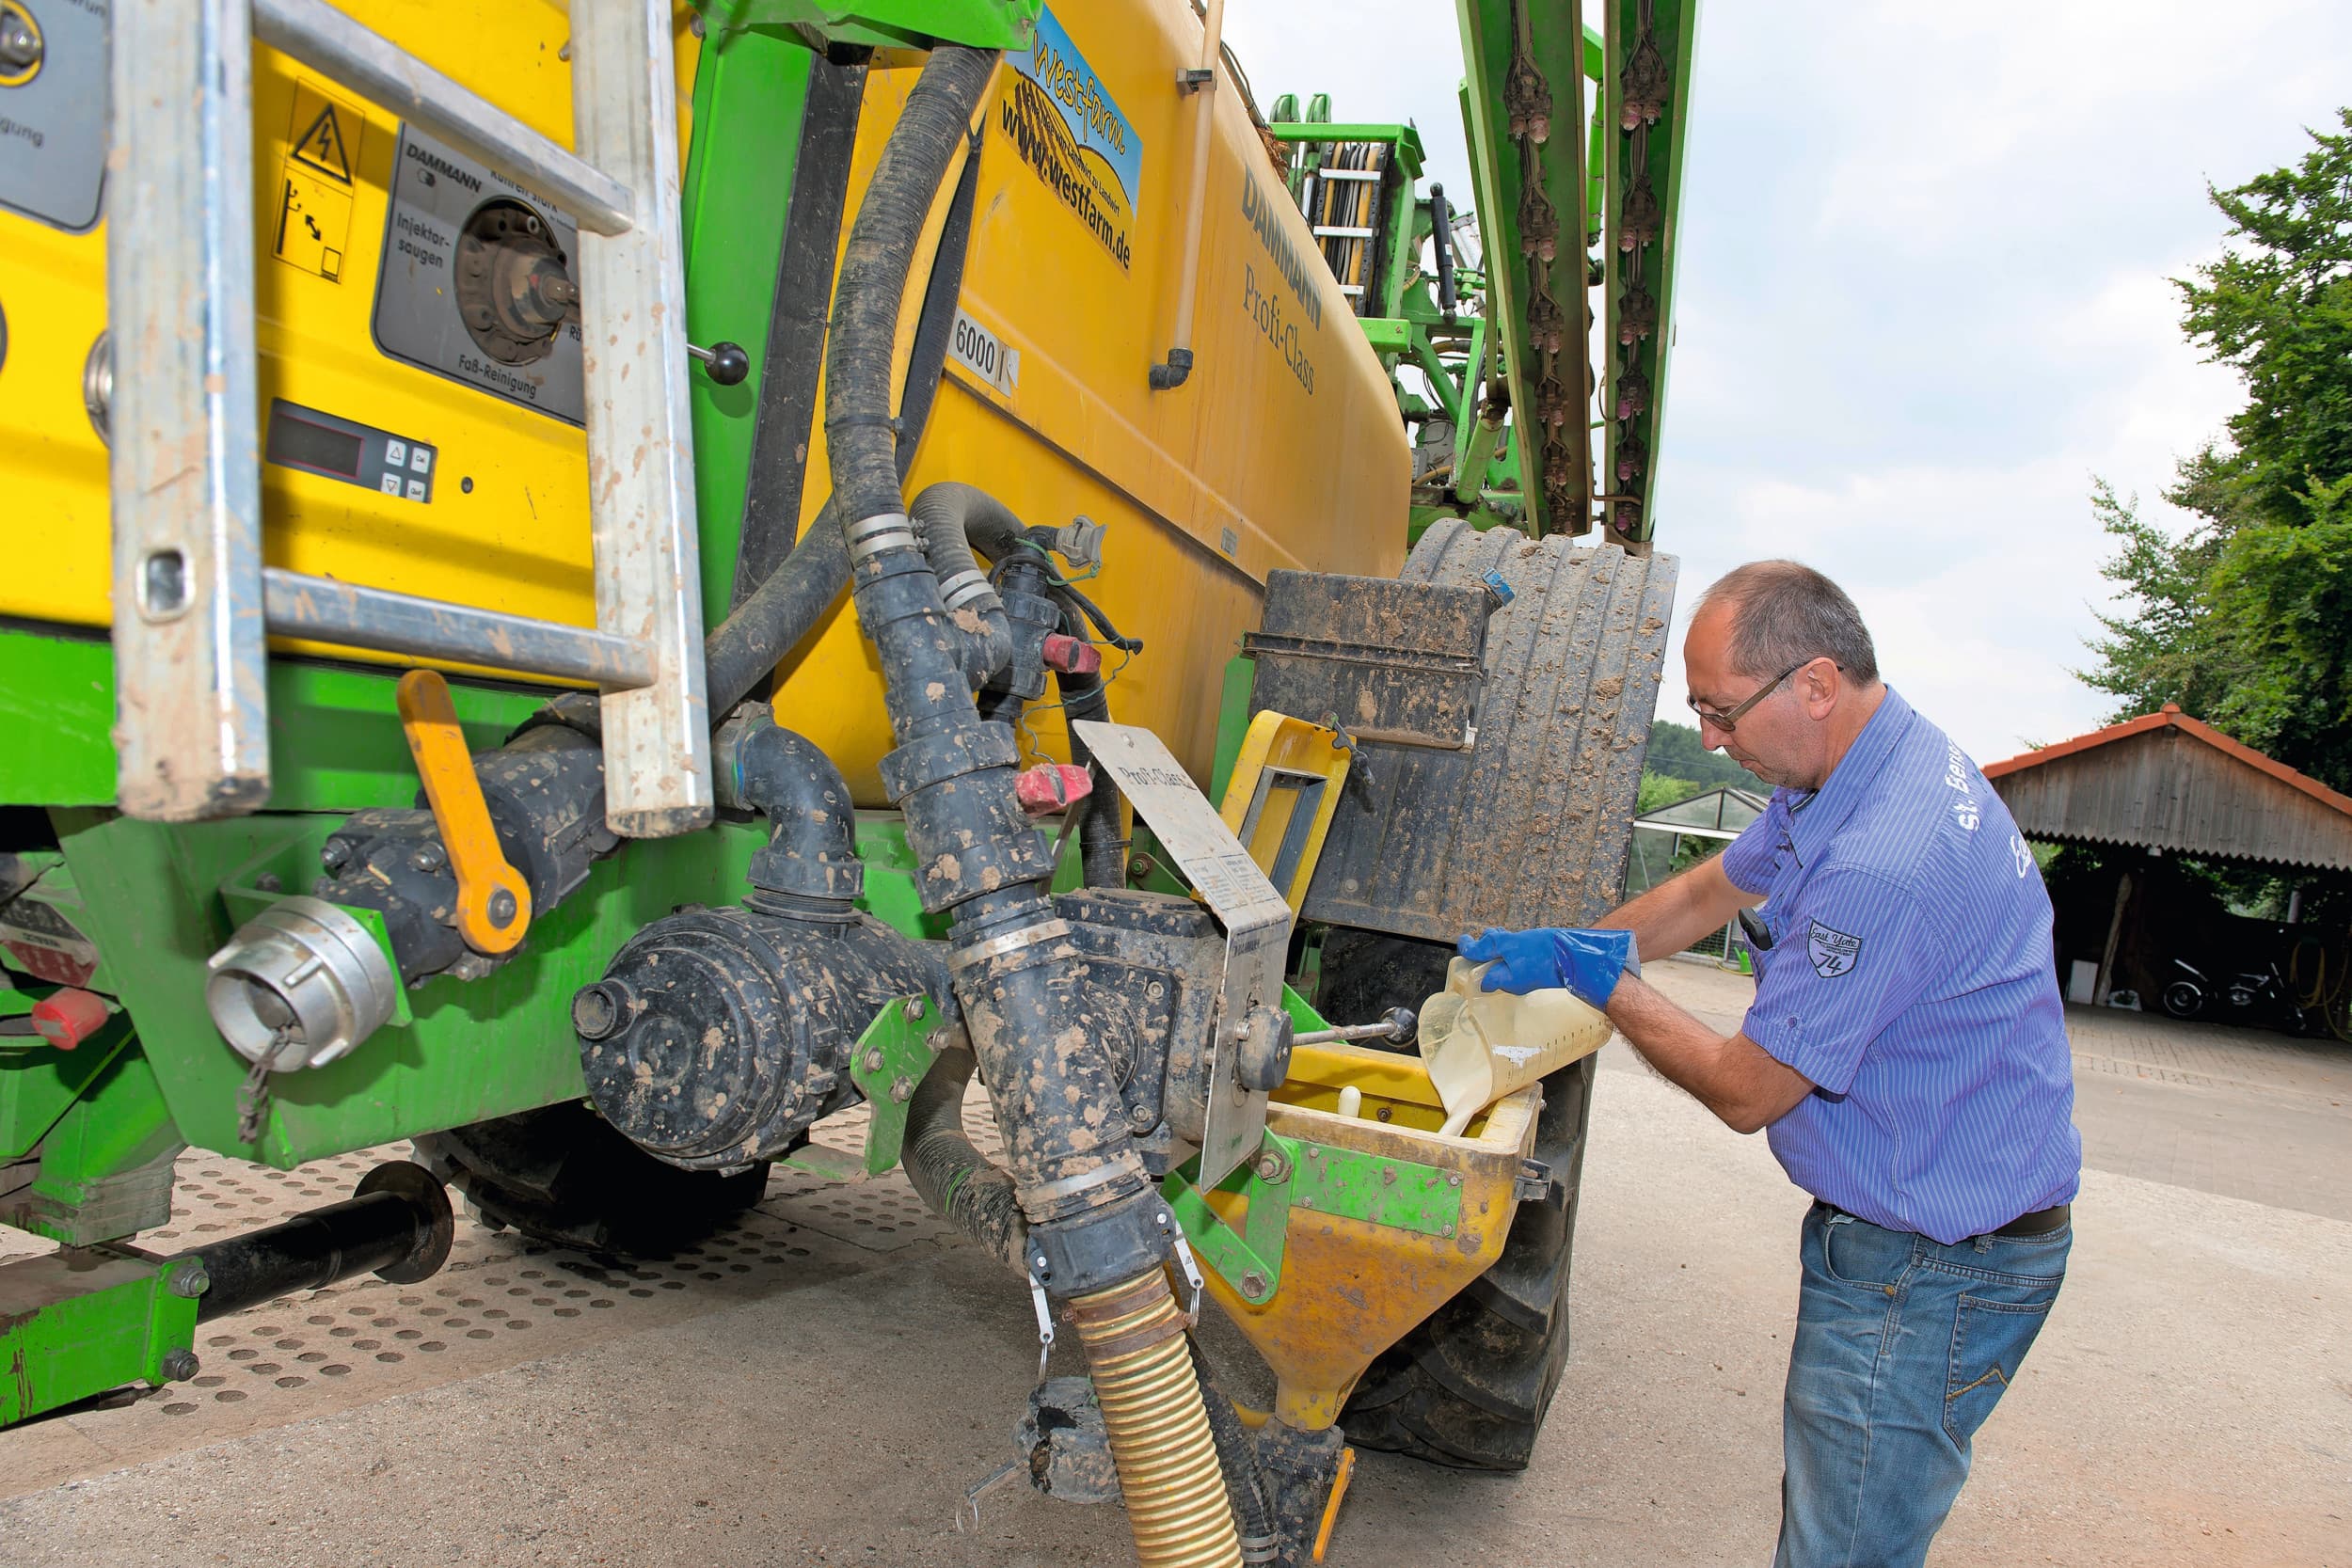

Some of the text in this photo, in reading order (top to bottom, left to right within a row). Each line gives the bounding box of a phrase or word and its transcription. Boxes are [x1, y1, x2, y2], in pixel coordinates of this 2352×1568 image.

[406, 143, 483, 194] DAMMANN
[1002, 99, 1131, 270] www.westfarm.de
[1067, 141, 1092, 182] Landwirt
[1091, 175, 1100, 190] zu
[1099, 180, 1120, 218] Landwirt
[397, 213, 452, 247] Injektor-
[398, 238, 444, 268] saugen
[1242, 162, 1323, 331] DAMMANN
[956, 318, 995, 374] 6000
[1243, 262, 1315, 396] Profi-Class
[458, 354, 536, 400] Faß-Reinigung
[1817, 952, 1842, 974] 74
